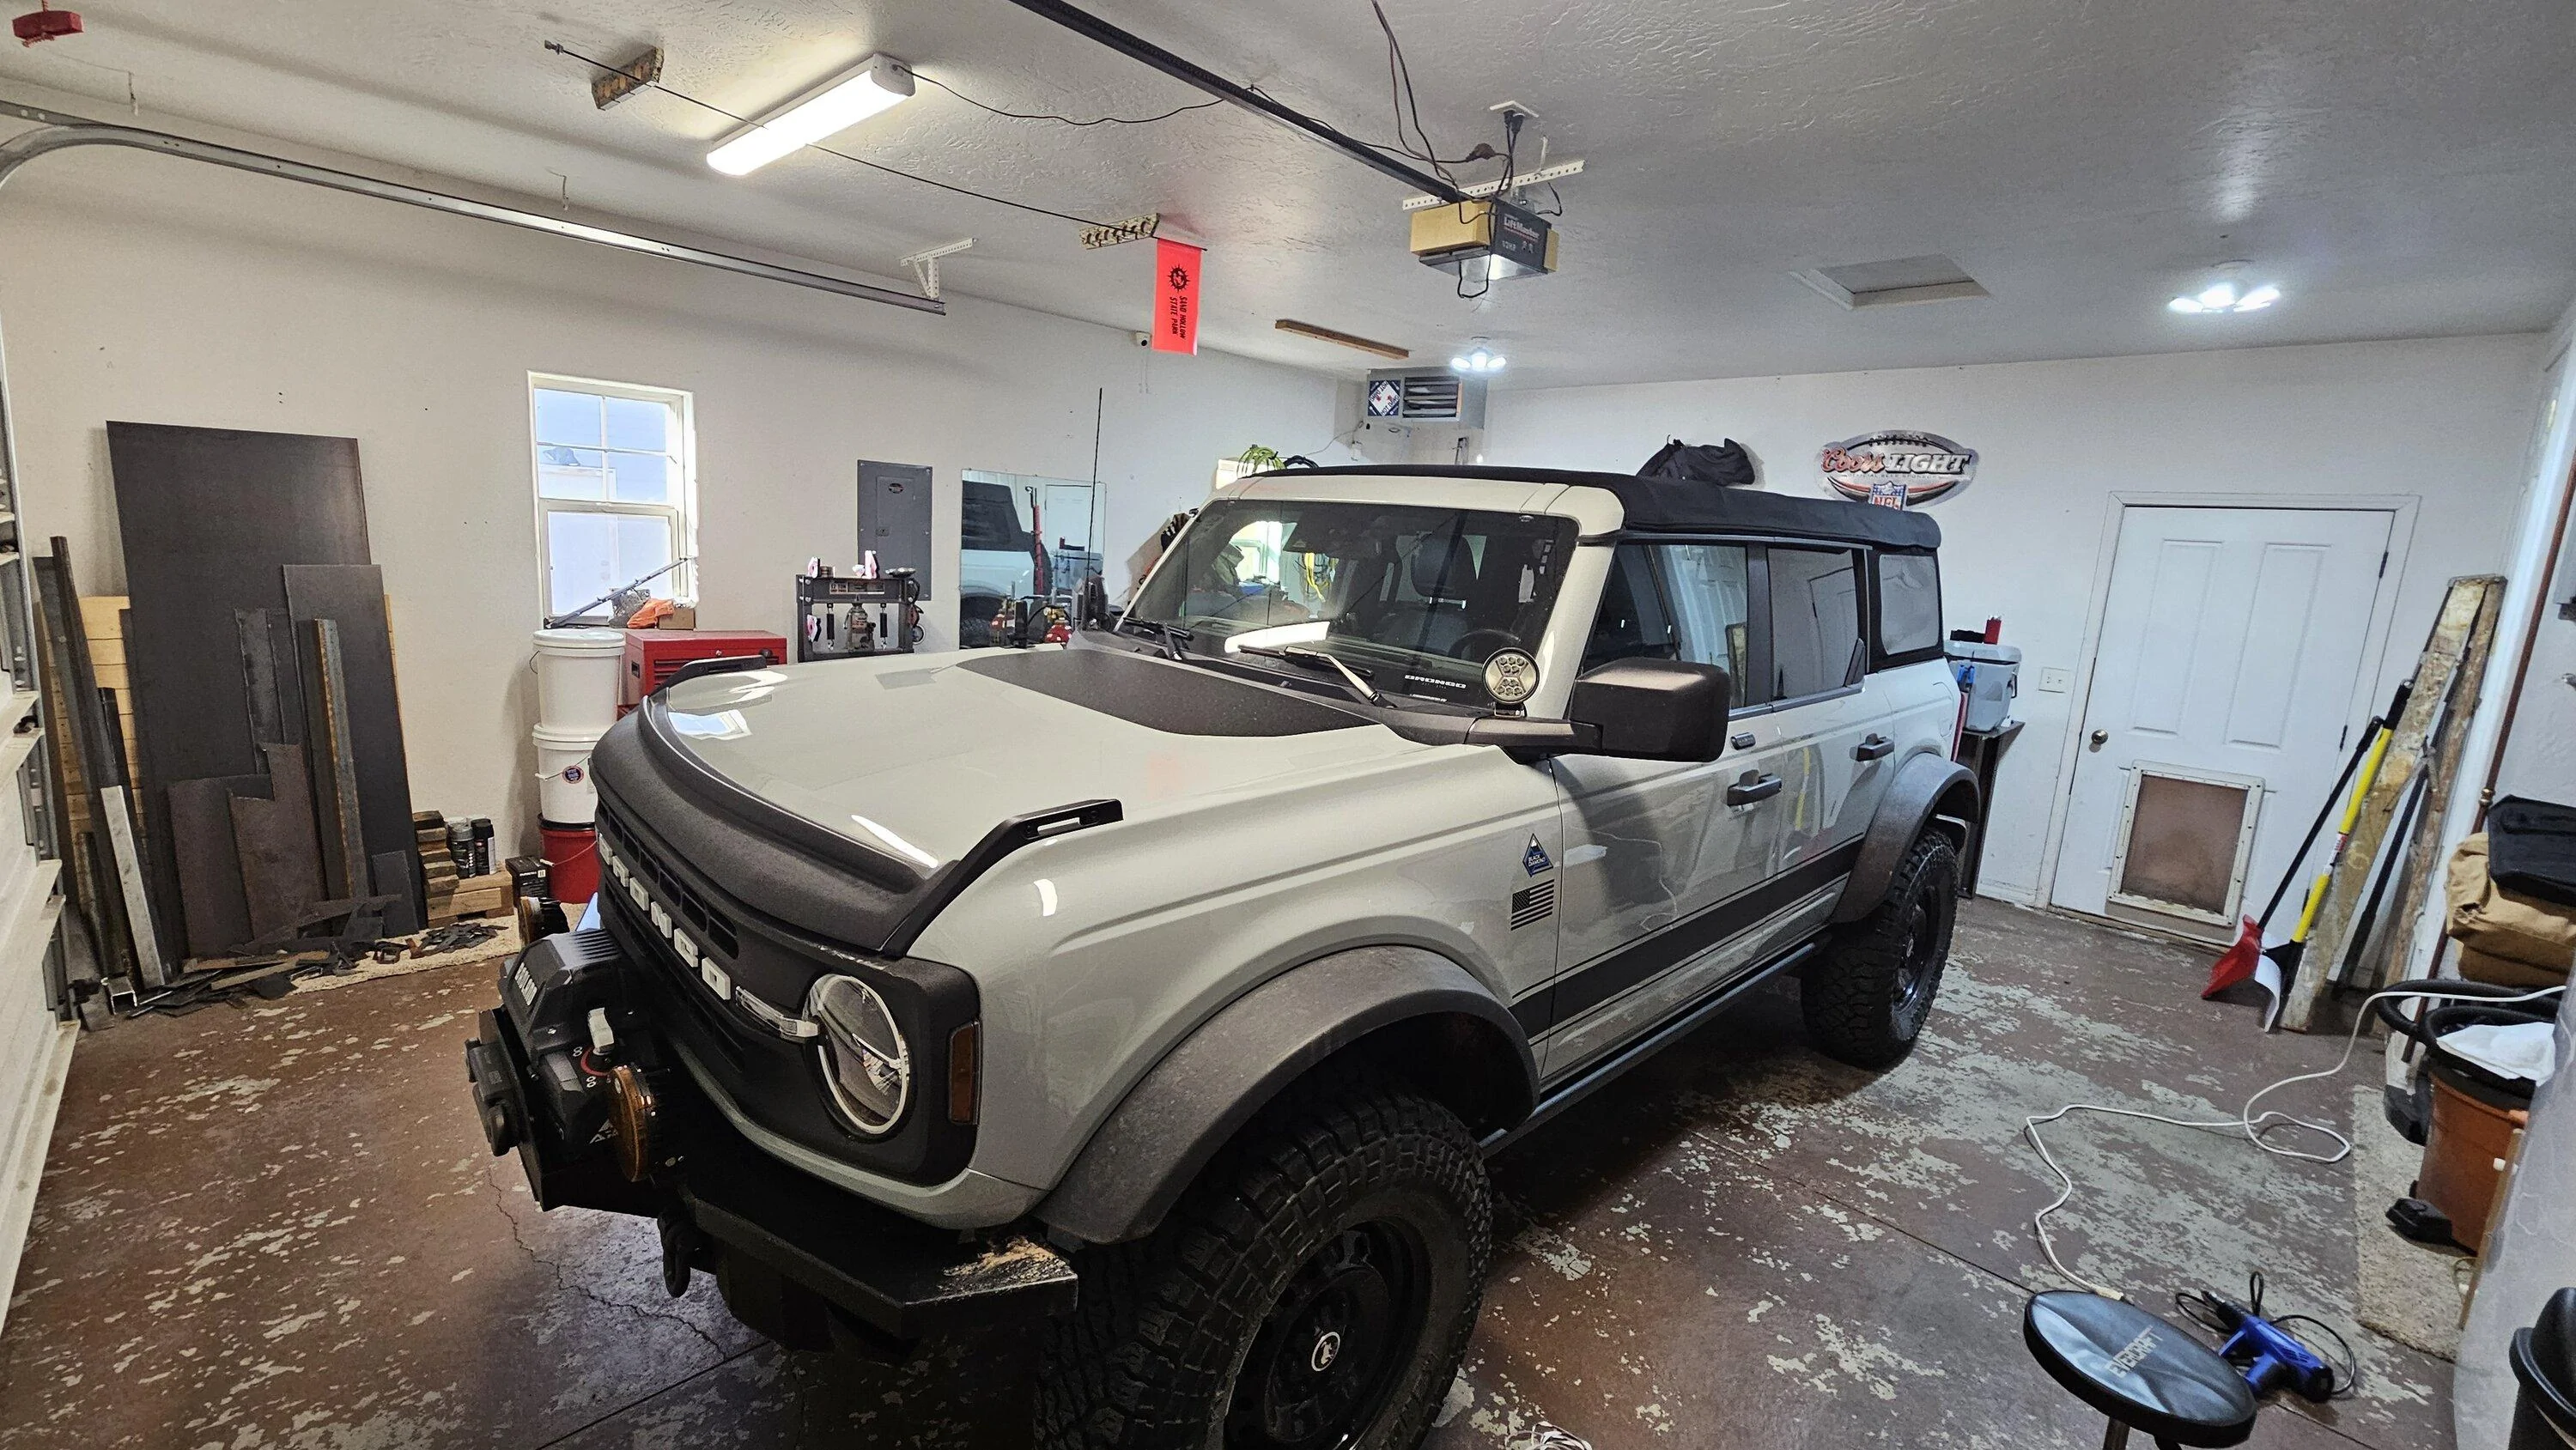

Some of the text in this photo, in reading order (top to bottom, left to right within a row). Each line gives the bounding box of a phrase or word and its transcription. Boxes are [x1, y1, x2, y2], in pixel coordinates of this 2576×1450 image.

[1504, 216, 1540, 239] LiftMaster
[1170, 296, 1178, 315] STATE
[1179, 295, 1188, 313] SAND
[1820, 446, 1971, 475] Coors LIGHT
[1405, 674, 1467, 689] BRONCO
[598, 833, 731, 1000] BRONCO
